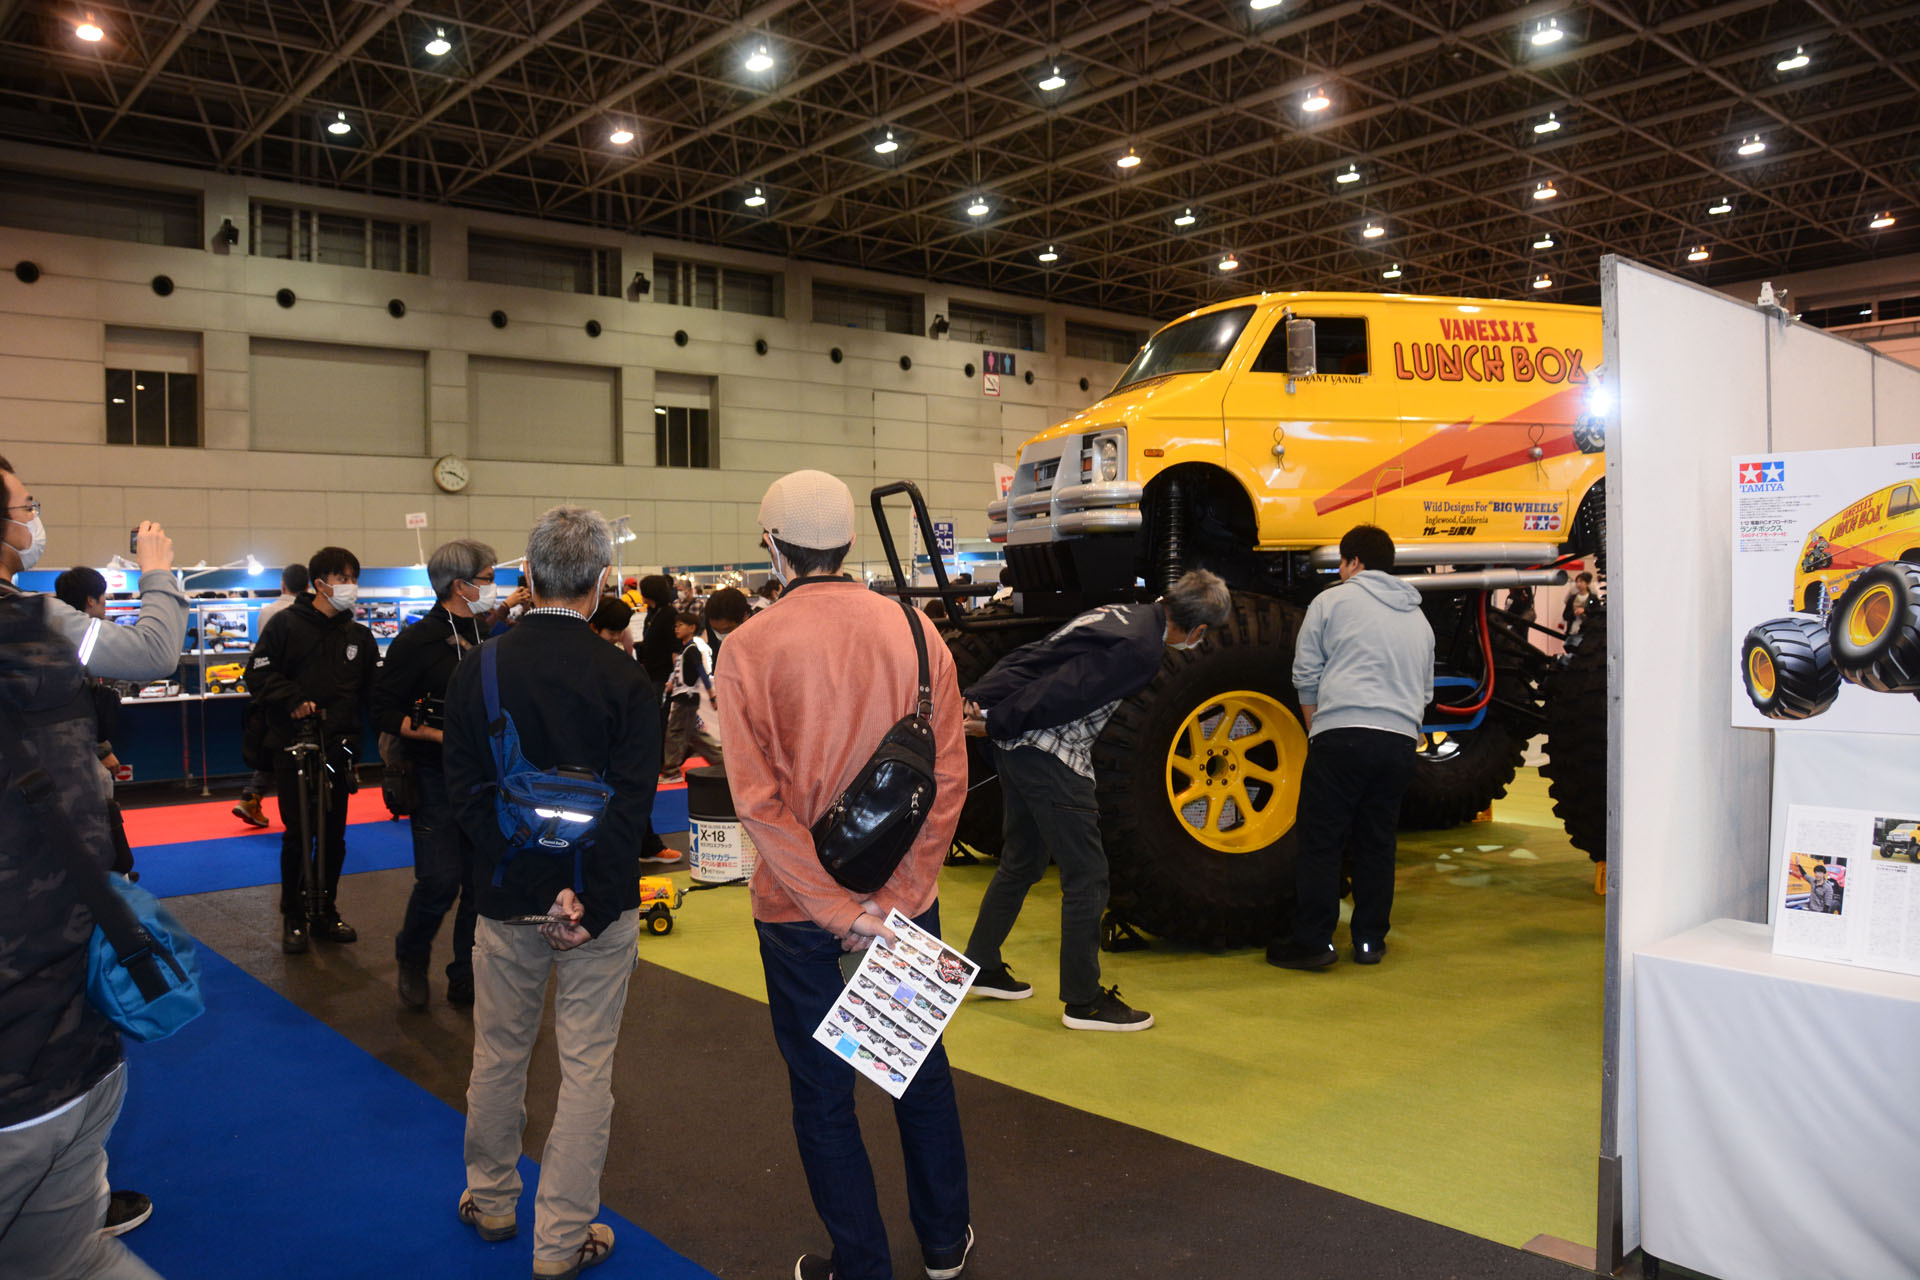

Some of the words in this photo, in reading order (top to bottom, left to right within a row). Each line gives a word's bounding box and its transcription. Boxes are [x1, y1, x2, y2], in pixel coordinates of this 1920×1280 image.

[1439, 318, 1538, 343] VANESSA'S
[1394, 342, 1505, 382] LUNCH
[1511, 345, 1588, 384] BOX
[1740, 483, 1784, 493] TAMIYA
[1423, 501, 1442, 512] Wild
[1444, 501, 1474, 514] Designs
[1475, 502, 1488, 512] For
[1458, 515, 1488, 524] California
[936, 538, 953, 550] 入口
[701, 829, 725, 842] X-18
[701, 853, 737, 861] タミヤカラー
